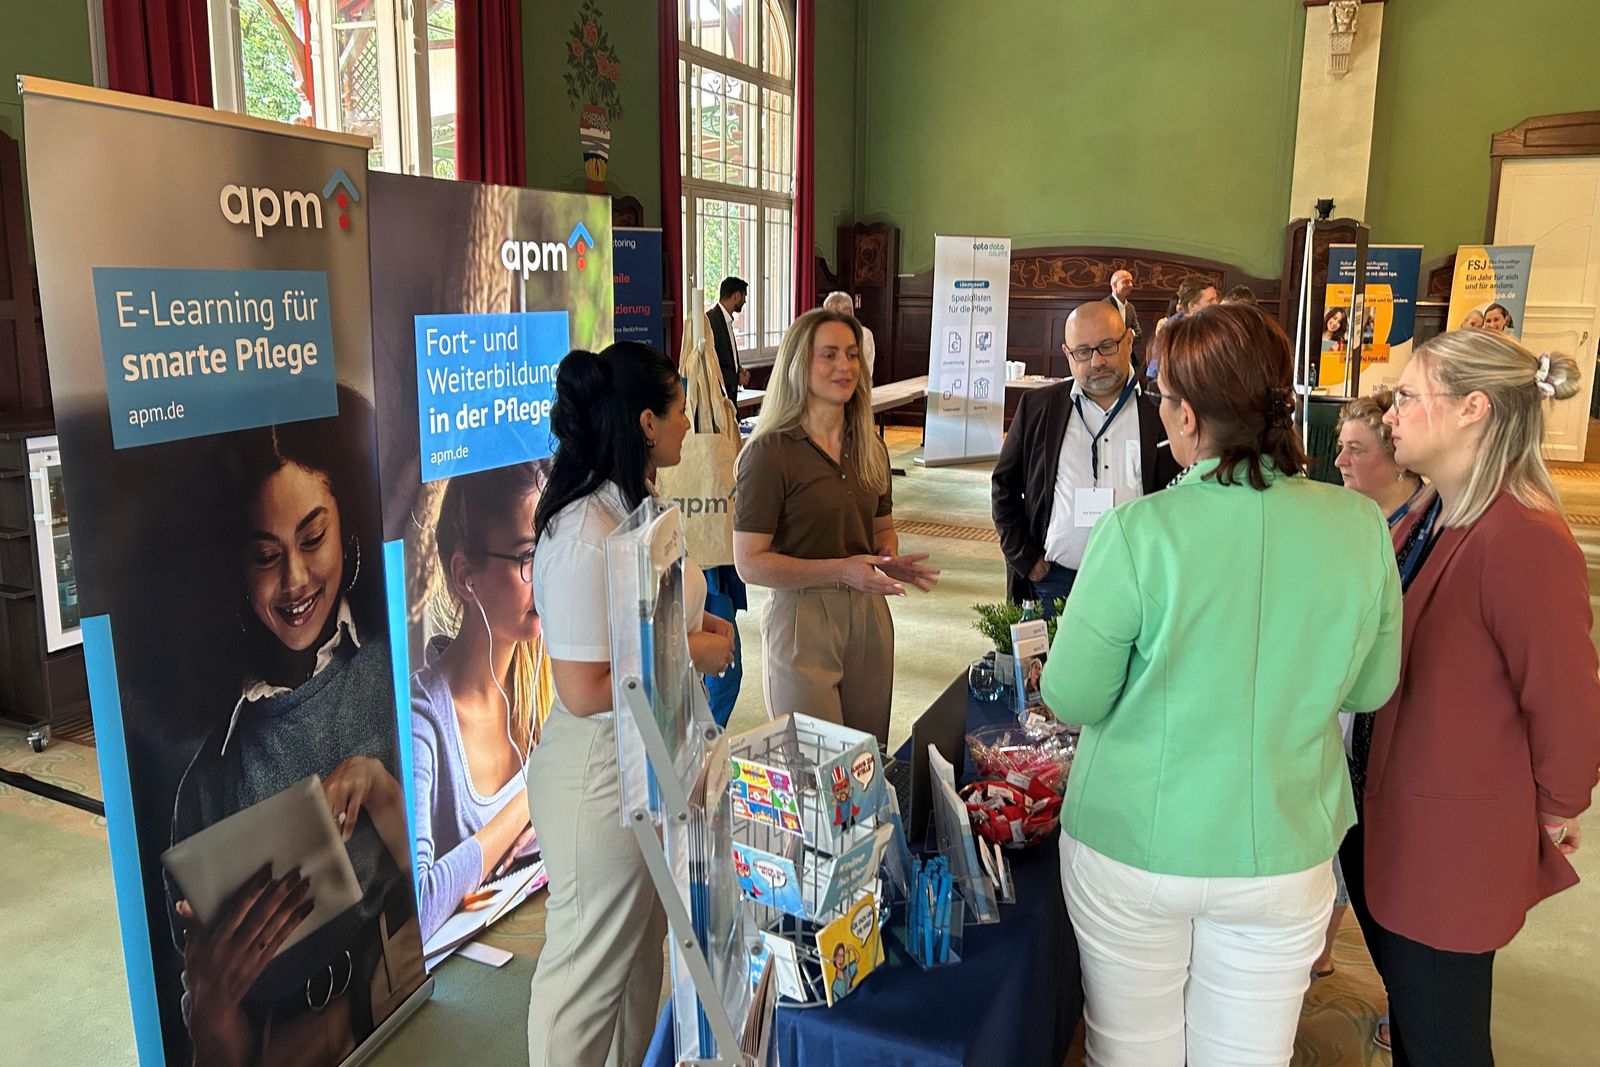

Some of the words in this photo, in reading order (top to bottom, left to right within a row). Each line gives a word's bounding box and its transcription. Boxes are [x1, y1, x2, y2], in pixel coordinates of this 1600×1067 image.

[219, 183, 323, 237] apm
[501, 239, 568, 280] apm
[1467, 259, 1487, 271] FSJ
[1466, 273, 1477, 281] Ein
[1478, 273, 1492, 281] Jahr
[1494, 273, 1504, 281] für
[115, 290, 275, 331] E-Learning
[282, 289, 318, 323] für
[948, 305, 958, 313] für
[960, 305, 970, 313] die
[972, 305, 993, 315] Pflege
[951, 294, 991, 303] Spezialisten
[425, 328, 476, 356] Fort-
[483, 325, 518, 352] und
[122, 343, 227, 382] smarte
[234, 336, 318, 375] Pflege
[128, 401, 185, 428] apm.de
[429, 407, 449, 435] in
[455, 404, 489, 431] der
[494, 396, 550, 425] Pflege
[430, 445, 469, 466] apm.de
